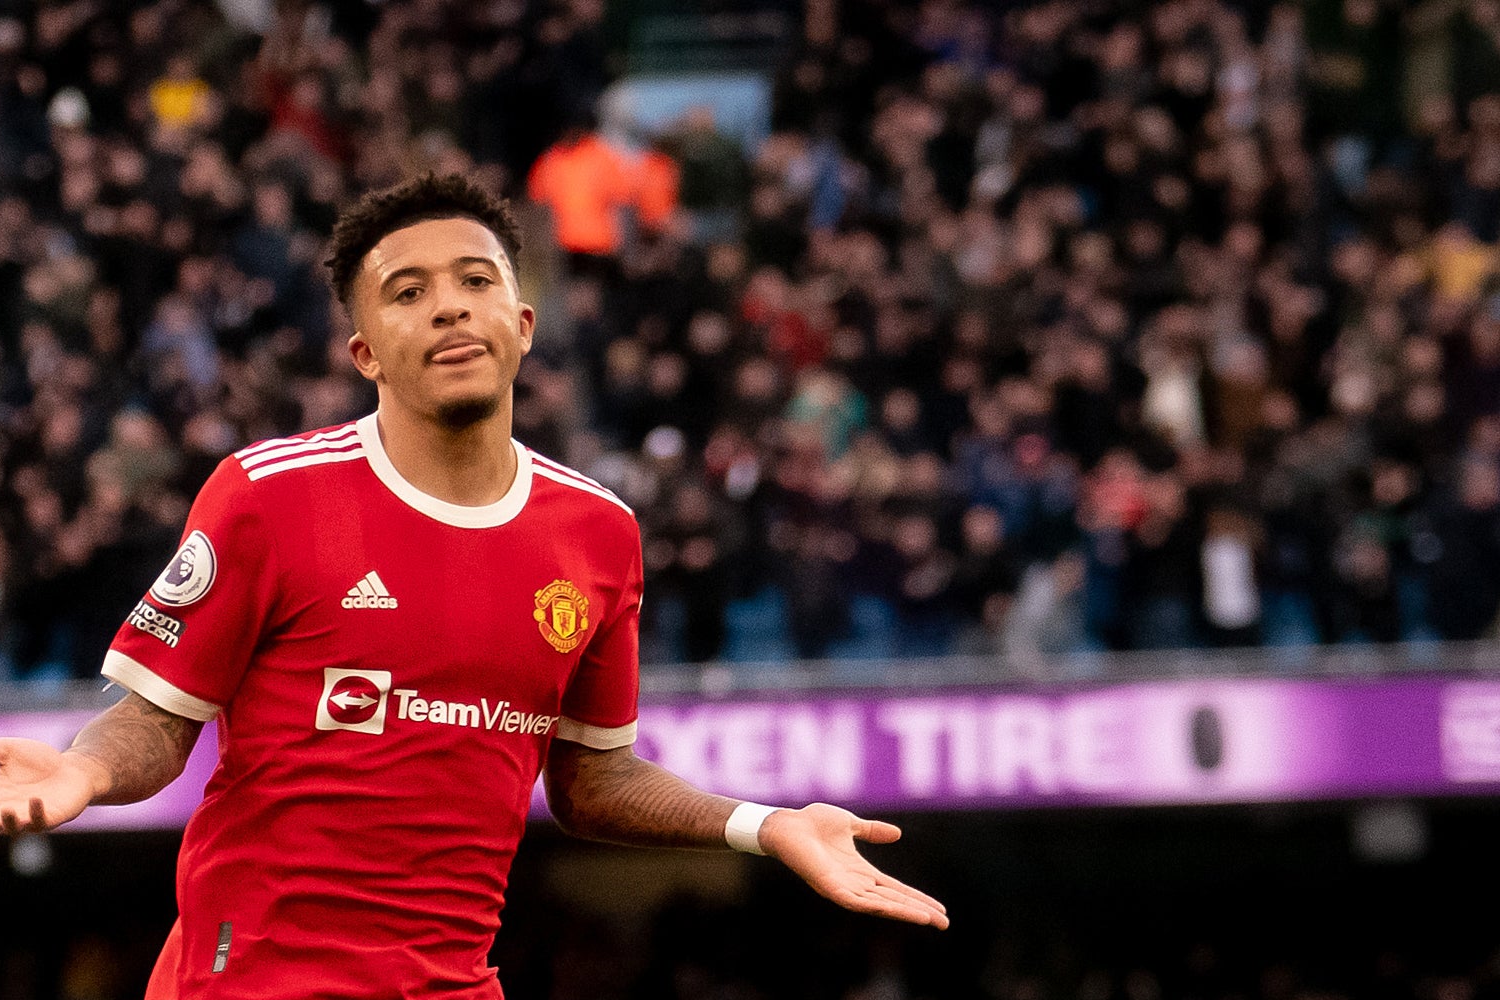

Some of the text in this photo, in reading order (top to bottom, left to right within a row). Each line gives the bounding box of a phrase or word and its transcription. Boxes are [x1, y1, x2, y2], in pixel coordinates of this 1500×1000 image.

[340, 595, 399, 609] adidas
[392, 688, 560, 735] TeamViewer
[638, 695, 1134, 798] XEN TIRE
